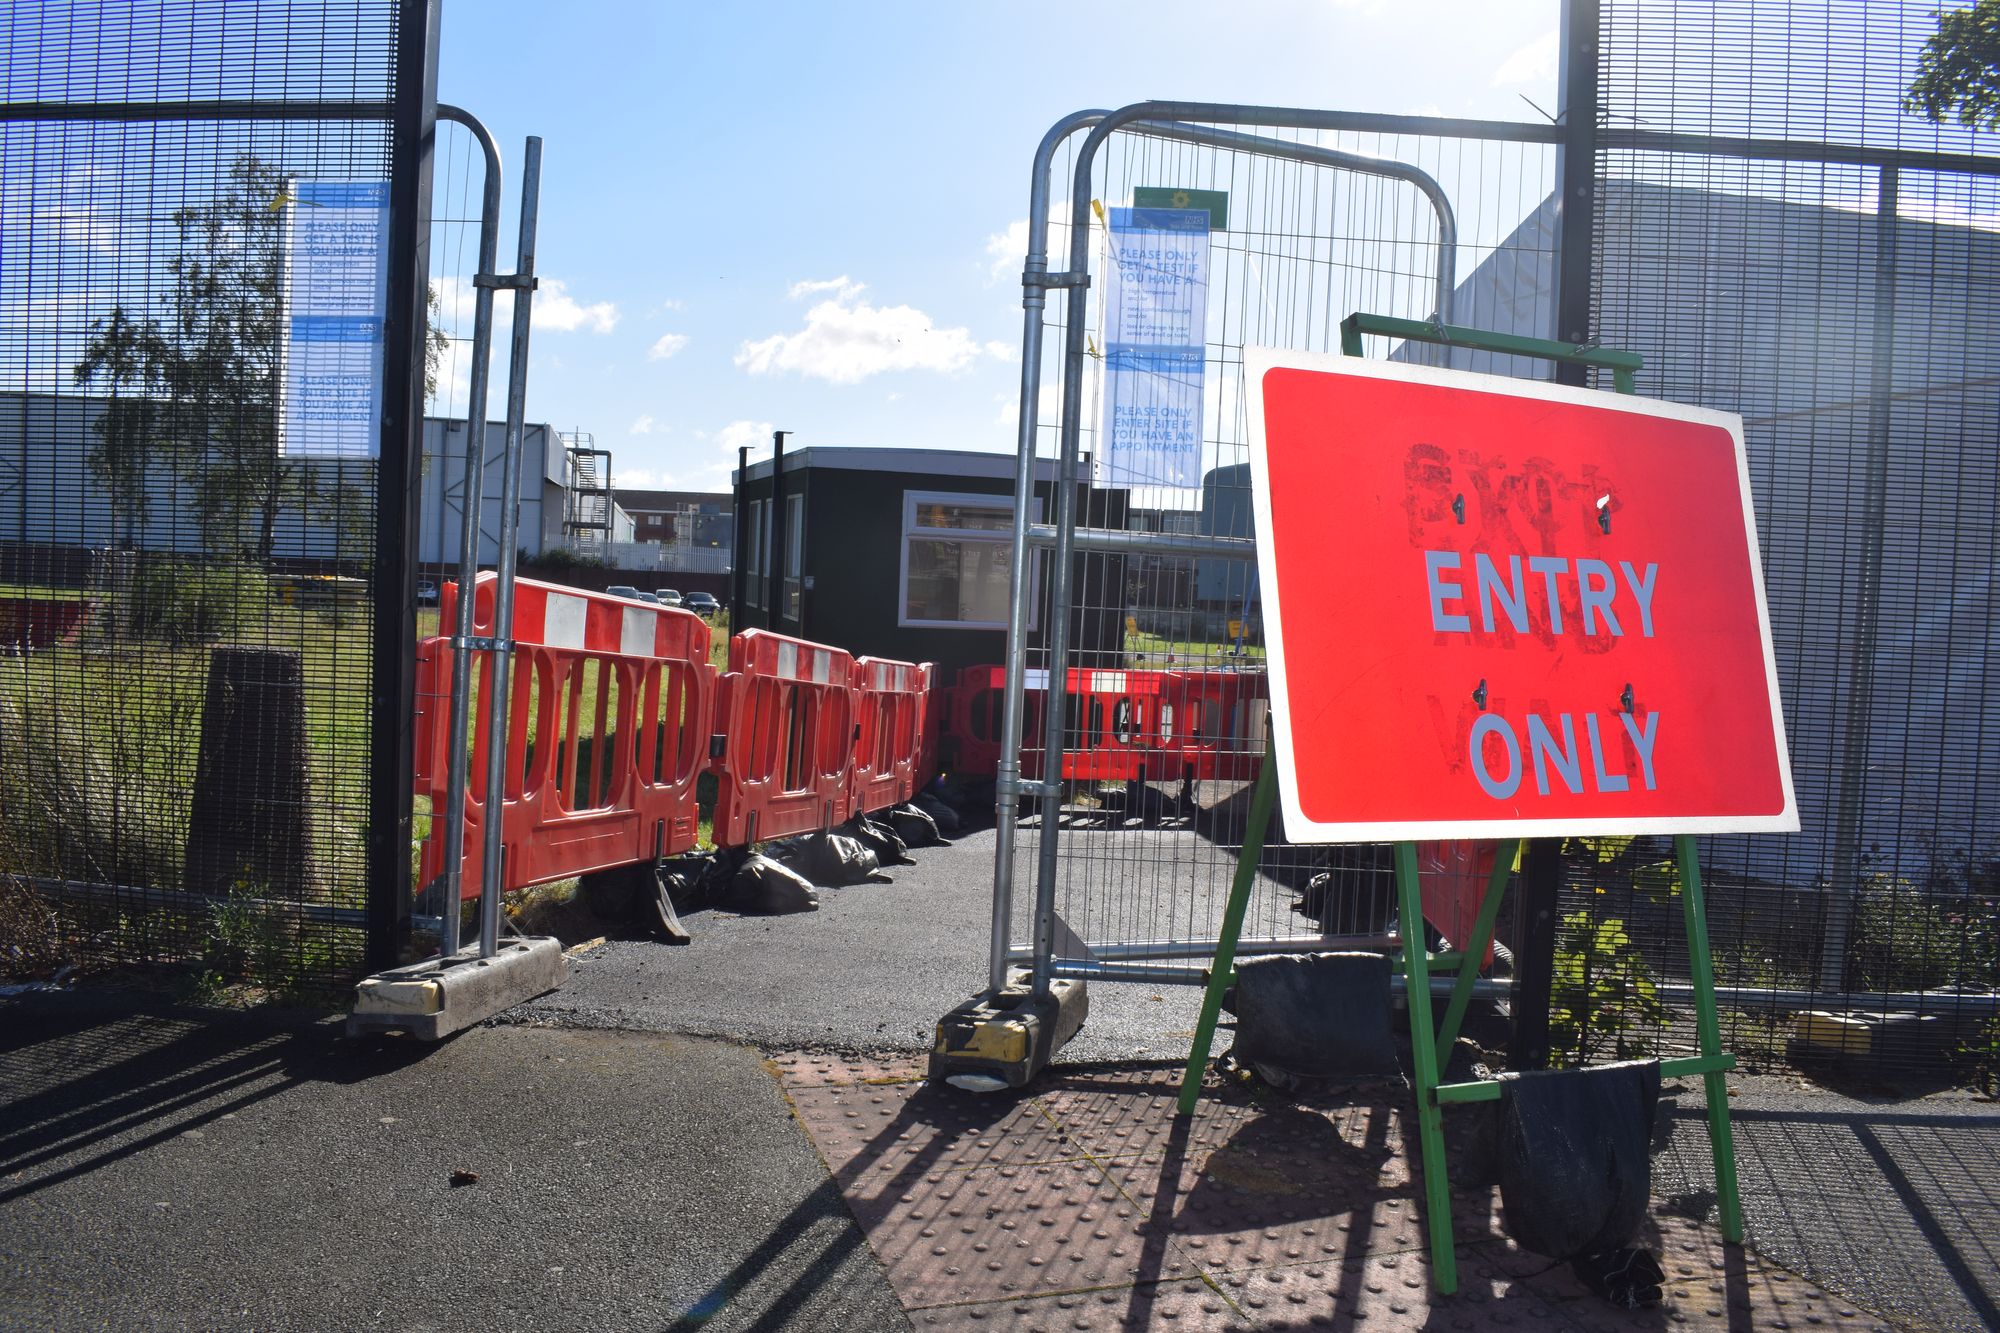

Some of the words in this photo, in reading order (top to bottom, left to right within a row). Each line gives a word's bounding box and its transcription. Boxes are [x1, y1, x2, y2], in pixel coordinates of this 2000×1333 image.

[1185, 216, 1204, 224] NHS
[1120, 248, 1160, 260] PLEASE
[1166, 250, 1198, 260] ONLY
[1120, 262, 1140, 270] GET
[1144, 262, 1152, 271] A
[1157, 263, 1184, 272] TEST
[1189, 264, 1199, 274] IF
[1120, 272, 1144, 283] YOU
[1149, 274, 1180, 285] HAVE
[1115, 406, 1156, 416] PLEASE
[1161, 408, 1192, 418] ONLY
[1114, 418, 1150, 428] ENTER
[1156, 420, 1178, 429] SITE
[1182, 420, 1192, 430] IF
[1112, 430, 1136, 440] YOU
[1142, 430, 1172, 440] HAVE
[1176, 432, 1194, 441] AN
[1111, 442, 1194, 453] APPOINTMENT
[1425, 550, 1659, 637] ENTRY
[1469, 711, 1660, 800] ONLY
